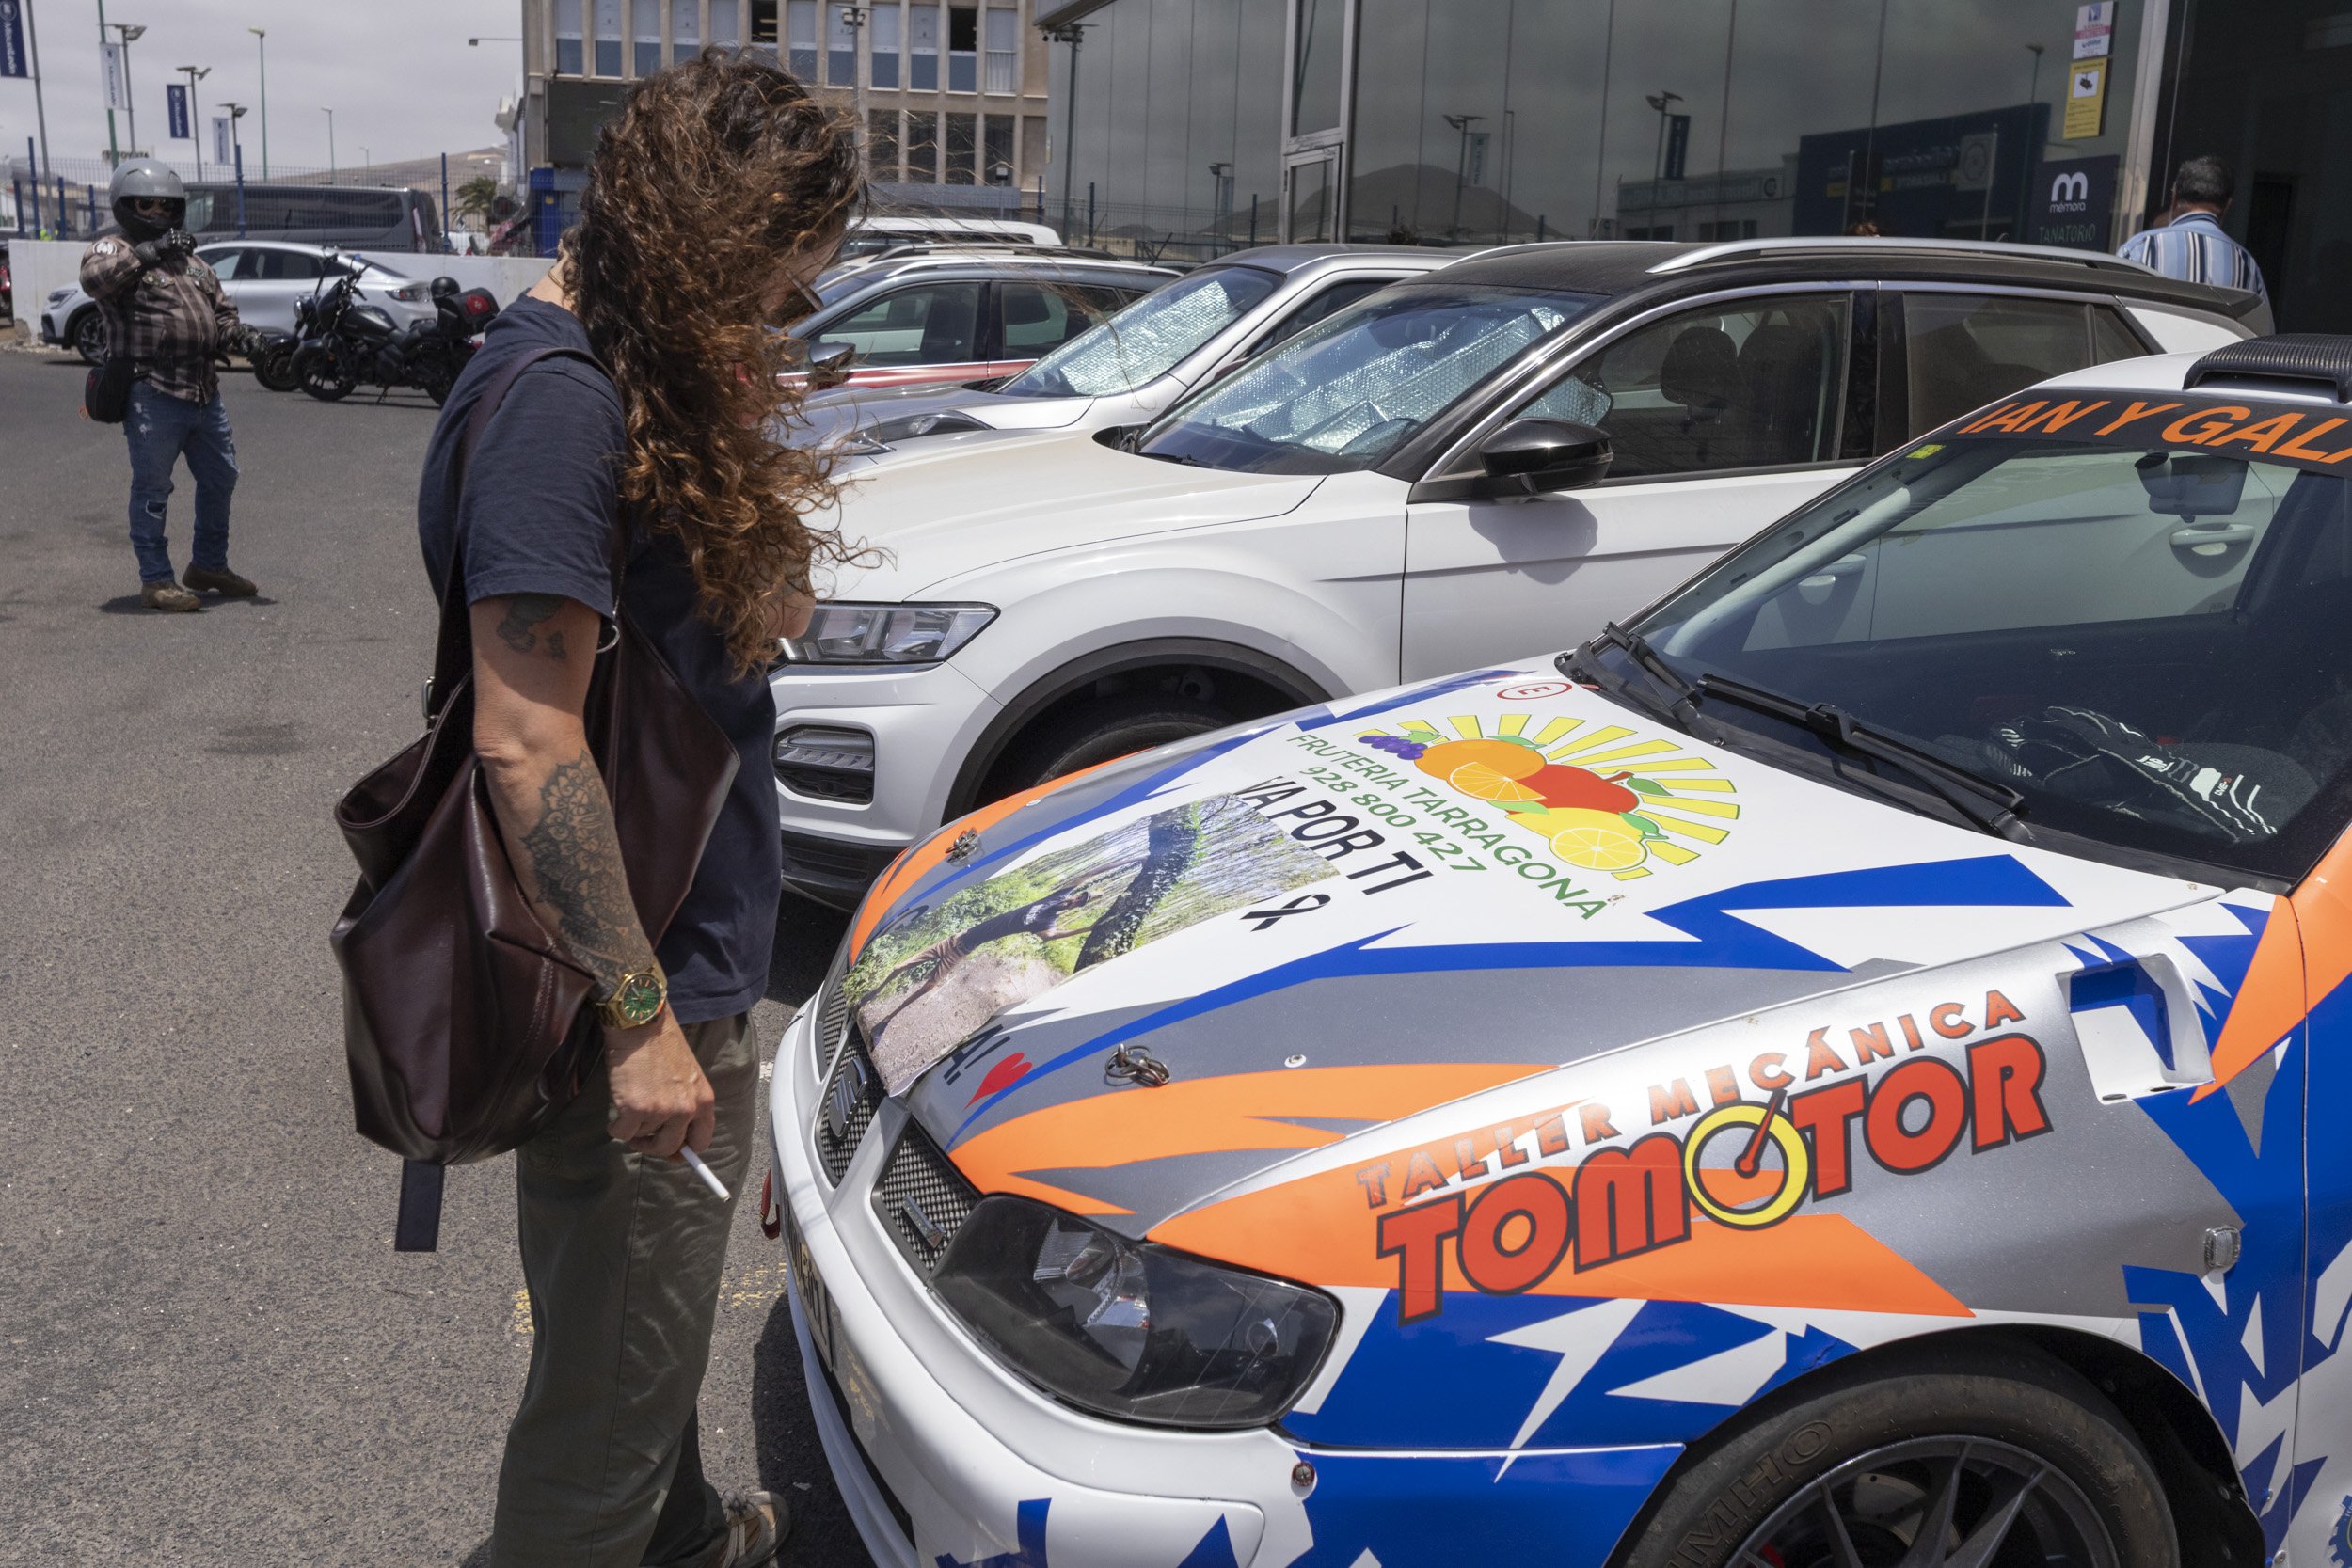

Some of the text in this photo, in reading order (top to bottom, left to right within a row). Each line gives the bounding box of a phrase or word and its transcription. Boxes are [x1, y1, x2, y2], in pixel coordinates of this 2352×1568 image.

[2093, 401, 2185, 436] Y
[1233, 775, 1434, 896] VA POR TI
[1286, 735, 1608, 920] FRUTERIA TARRAGONA
[1298, 766, 1487, 875] 928 800 427
[1356, 989, 2027, 1210] TALLER MECÁNICA
